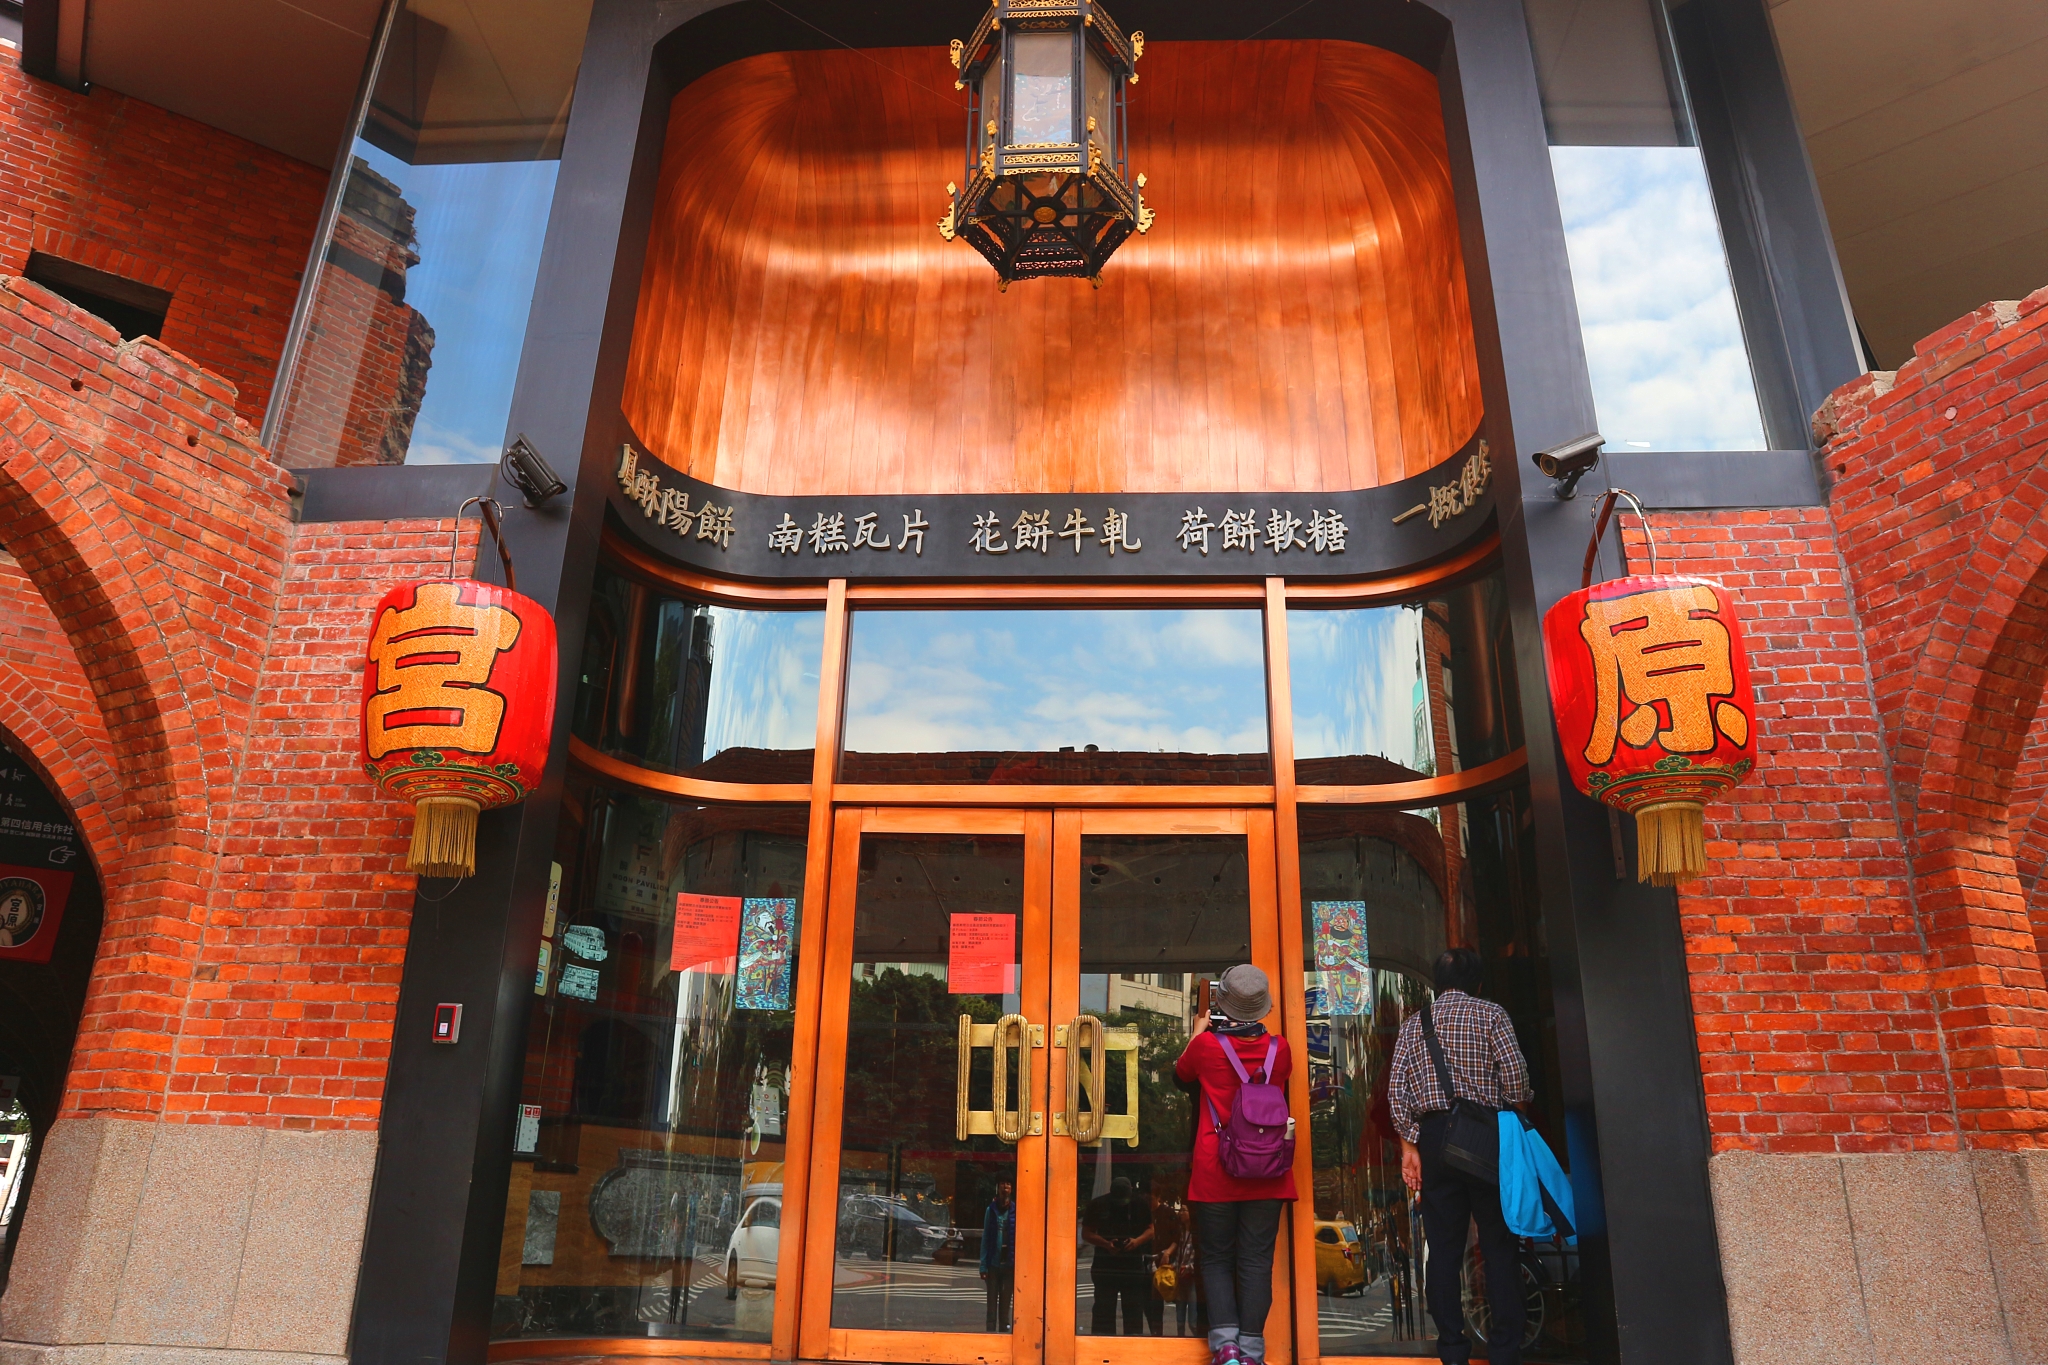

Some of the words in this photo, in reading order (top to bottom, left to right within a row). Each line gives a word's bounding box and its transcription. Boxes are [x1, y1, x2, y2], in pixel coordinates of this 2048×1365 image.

[617, 443, 736, 551] 鳳酥陽餅
[767, 507, 930, 556] 南糕瓦片
[967, 507, 1142, 557] 花餅牛軋
[1175, 506, 1349, 556] 荷餅軟糖
[364, 582, 522, 761] 宮
[1579, 585, 1748, 767] 原
[0, 817, 74, 836] 第四信用合作社
[5, 897, 23, 927] 宮原
